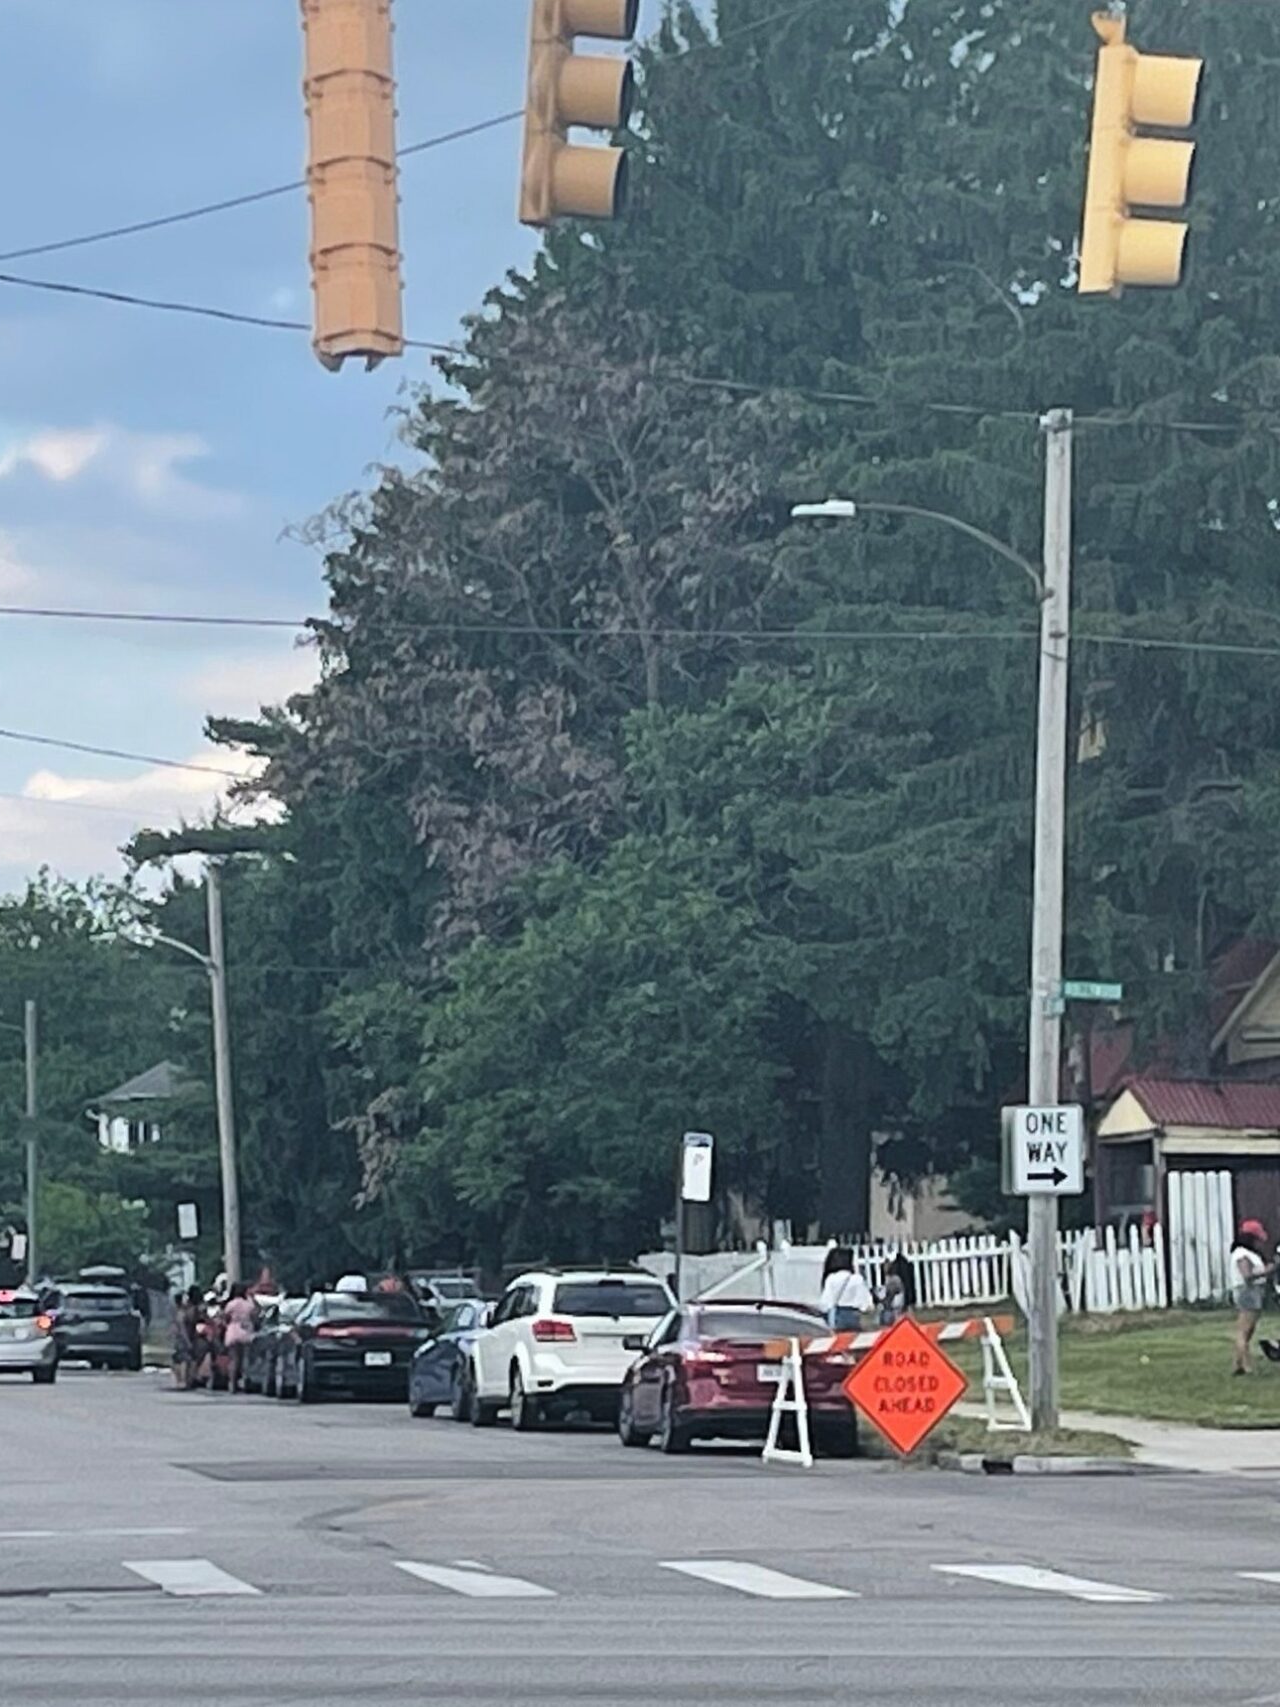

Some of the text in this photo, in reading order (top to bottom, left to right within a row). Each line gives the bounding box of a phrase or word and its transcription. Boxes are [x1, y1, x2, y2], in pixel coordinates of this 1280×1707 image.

[1026, 1112, 1067, 1134] ONE
[1026, 1141, 1068, 1163] WAY
[883, 1351, 930, 1368] ROAD
[873, 1375, 940, 1393] CLOSED
[878, 1396, 935, 1414] AHEAD
